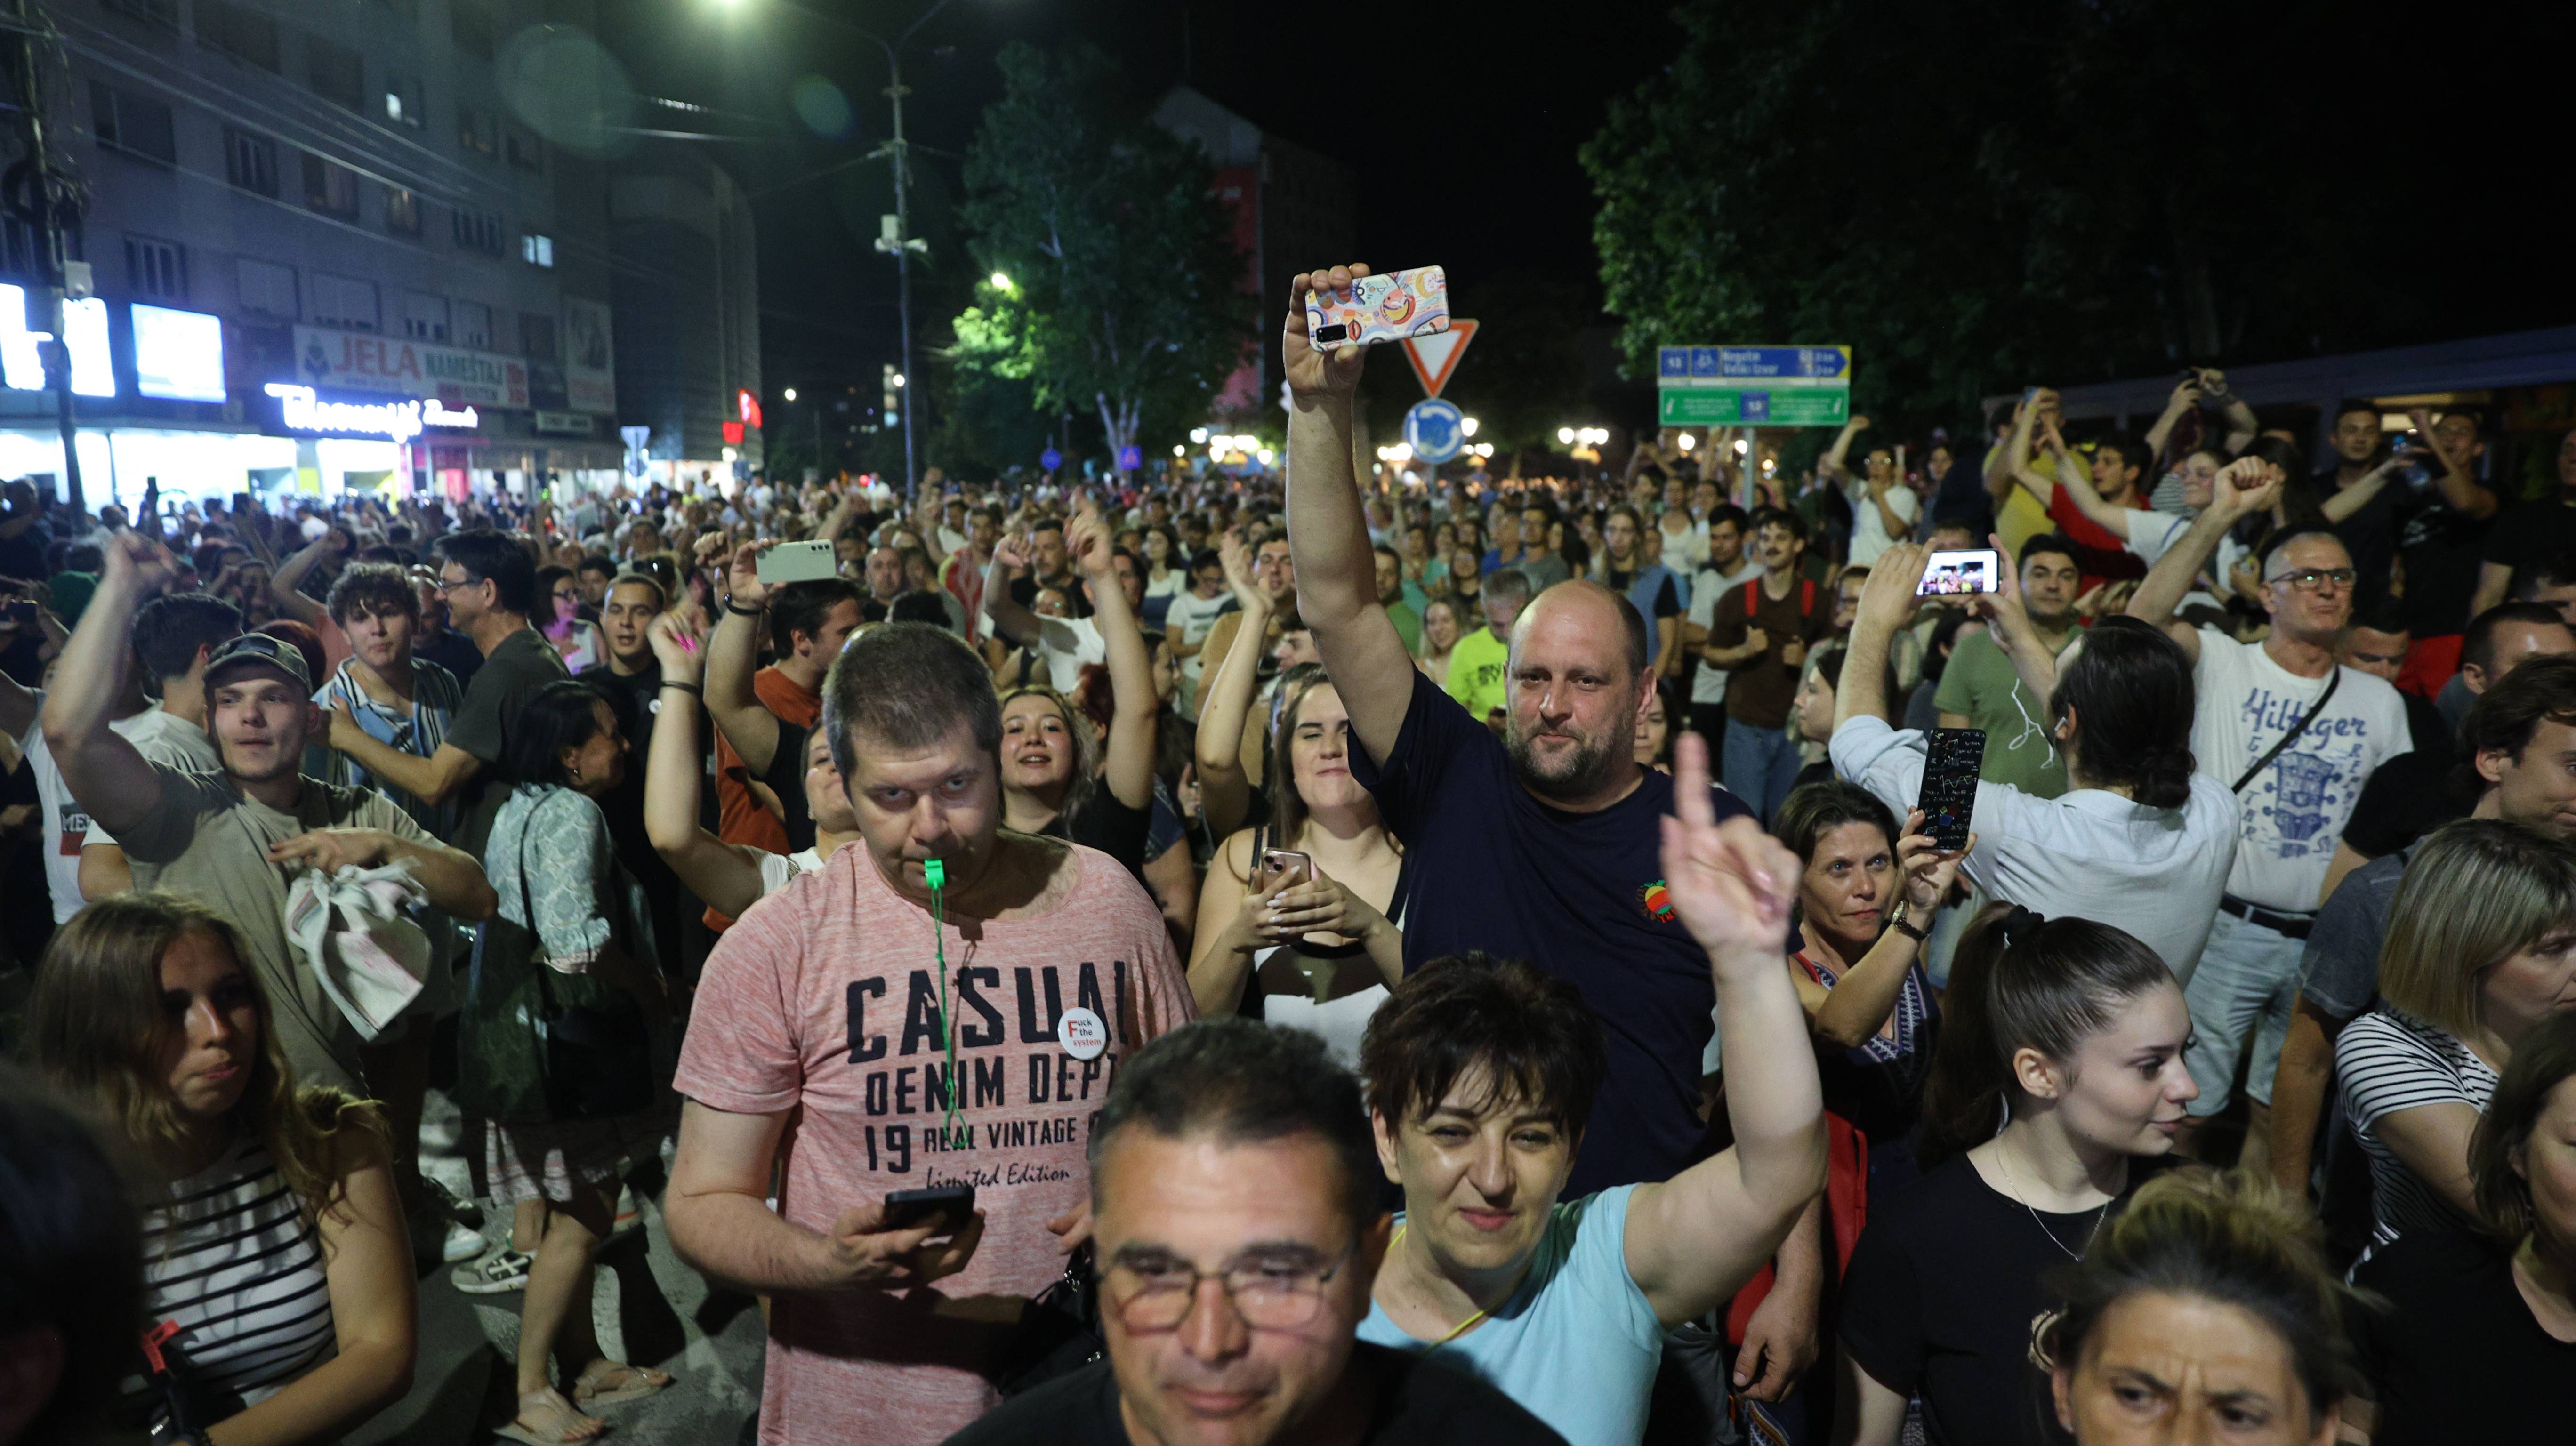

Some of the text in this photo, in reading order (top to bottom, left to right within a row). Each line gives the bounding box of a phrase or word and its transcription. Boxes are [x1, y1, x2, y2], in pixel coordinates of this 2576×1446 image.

[334, 336, 421, 380] JELA
[1068, 1018, 1092, 1037] Fuck
[1079, 1028, 1093, 1036] the
[1073, 1038, 1102, 1047] system
[866, 1056, 1004, 1115] DENIM
[865, 1125, 911, 1173] 19
[924, 1125, 976, 1153] REAL
[989, 1117, 1077, 1148] VINTAGE
[926, 1162, 1070, 1190] Limited Edition
